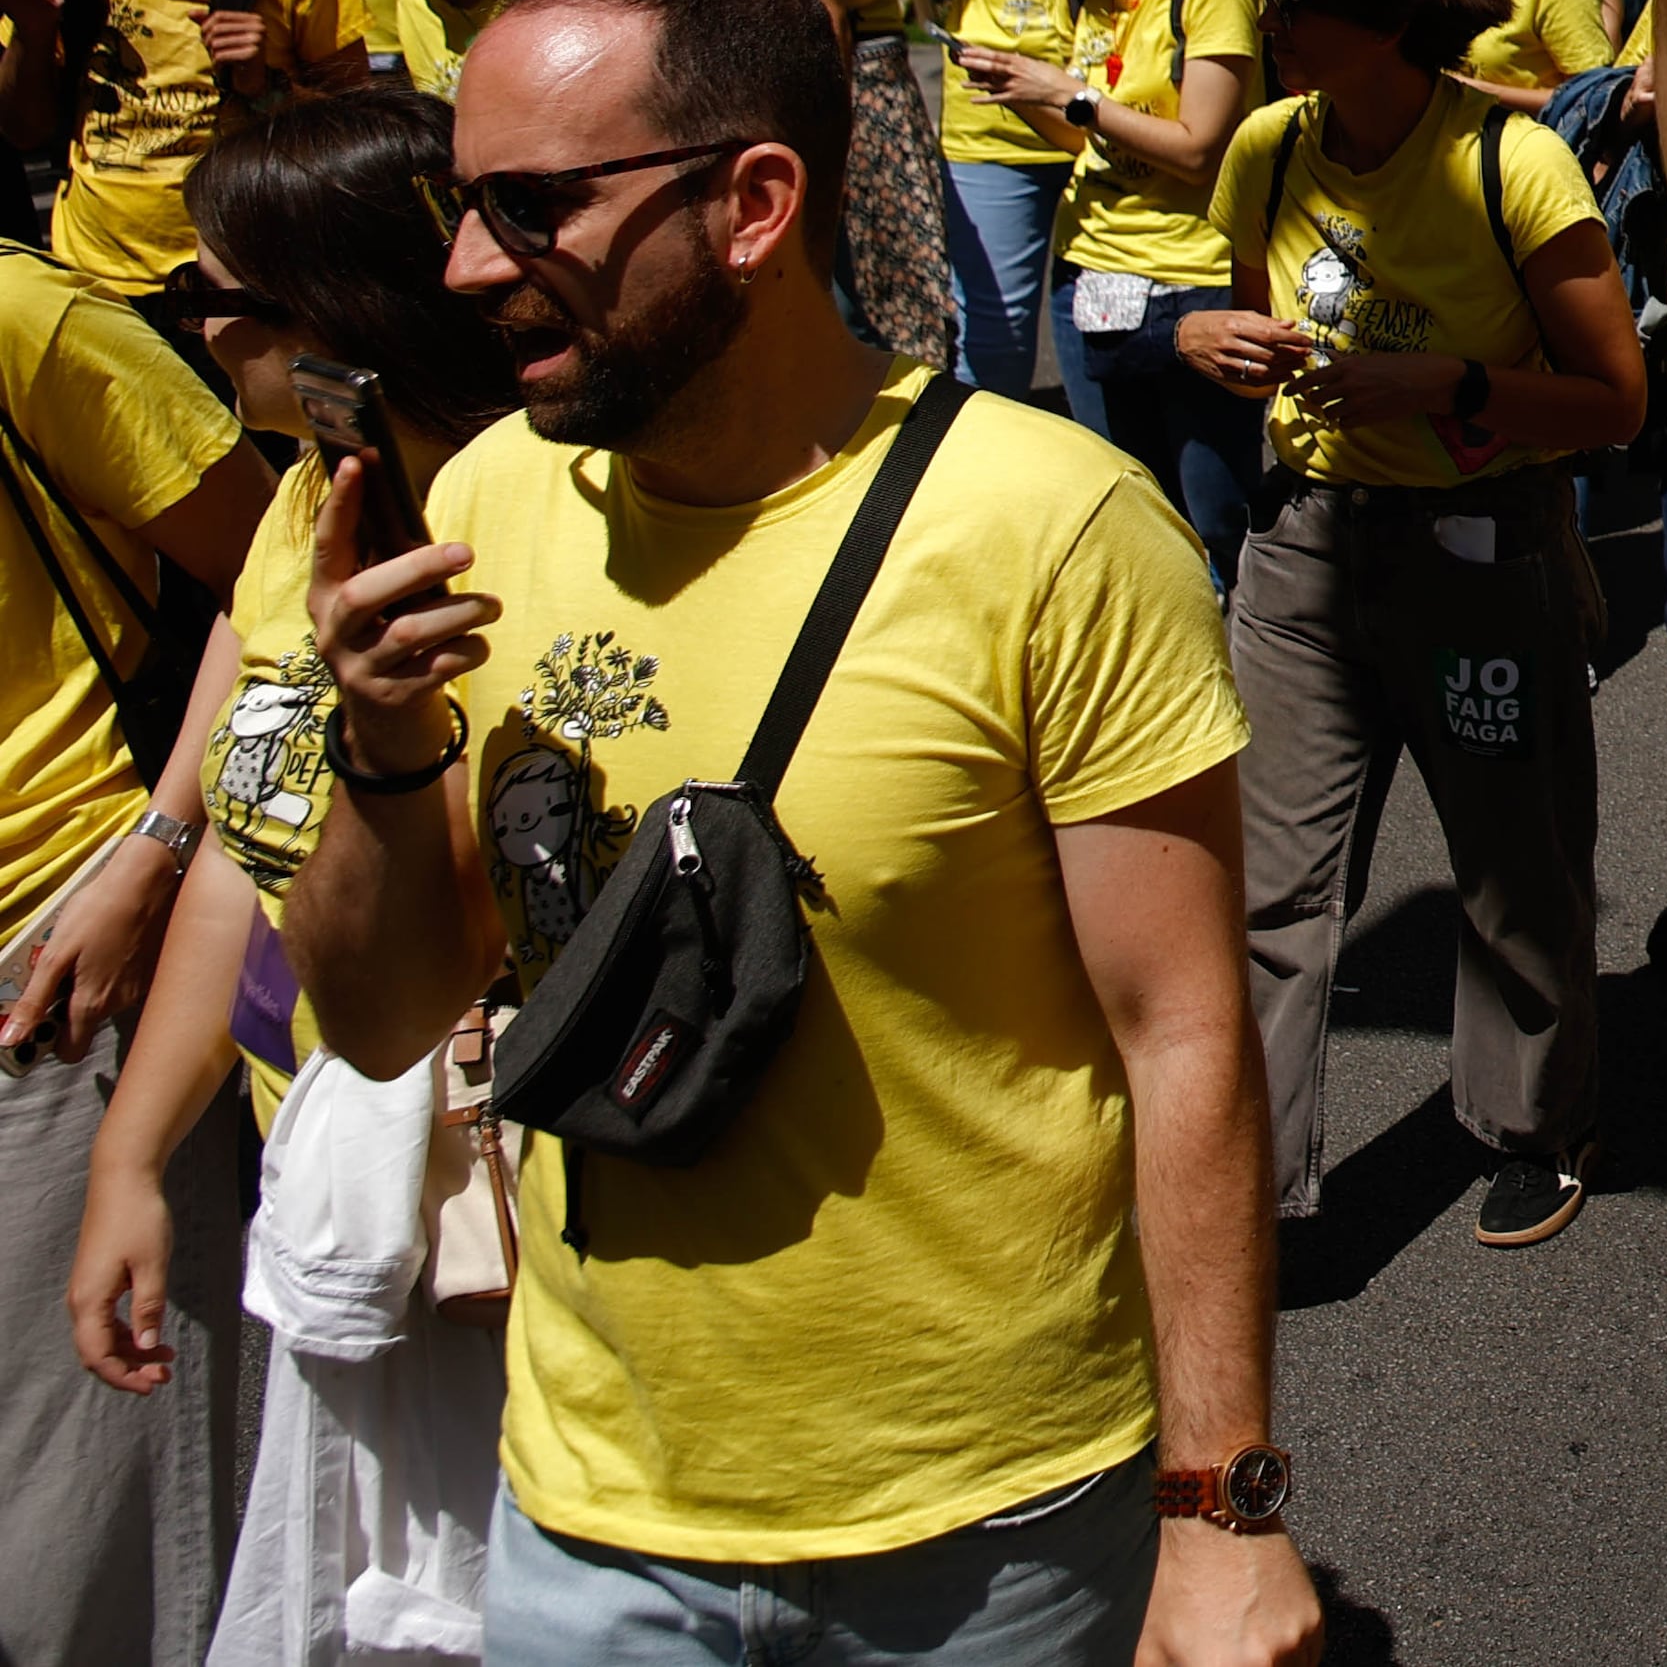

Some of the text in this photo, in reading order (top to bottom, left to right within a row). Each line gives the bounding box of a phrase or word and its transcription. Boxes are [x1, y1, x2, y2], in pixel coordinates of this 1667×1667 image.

[1445, 657, 1520, 696] JO
[1445, 691, 1520, 722] FAIG
[1447, 714, 1519, 743] VAGA
[622, 1027, 674, 1099] EASTPAK
